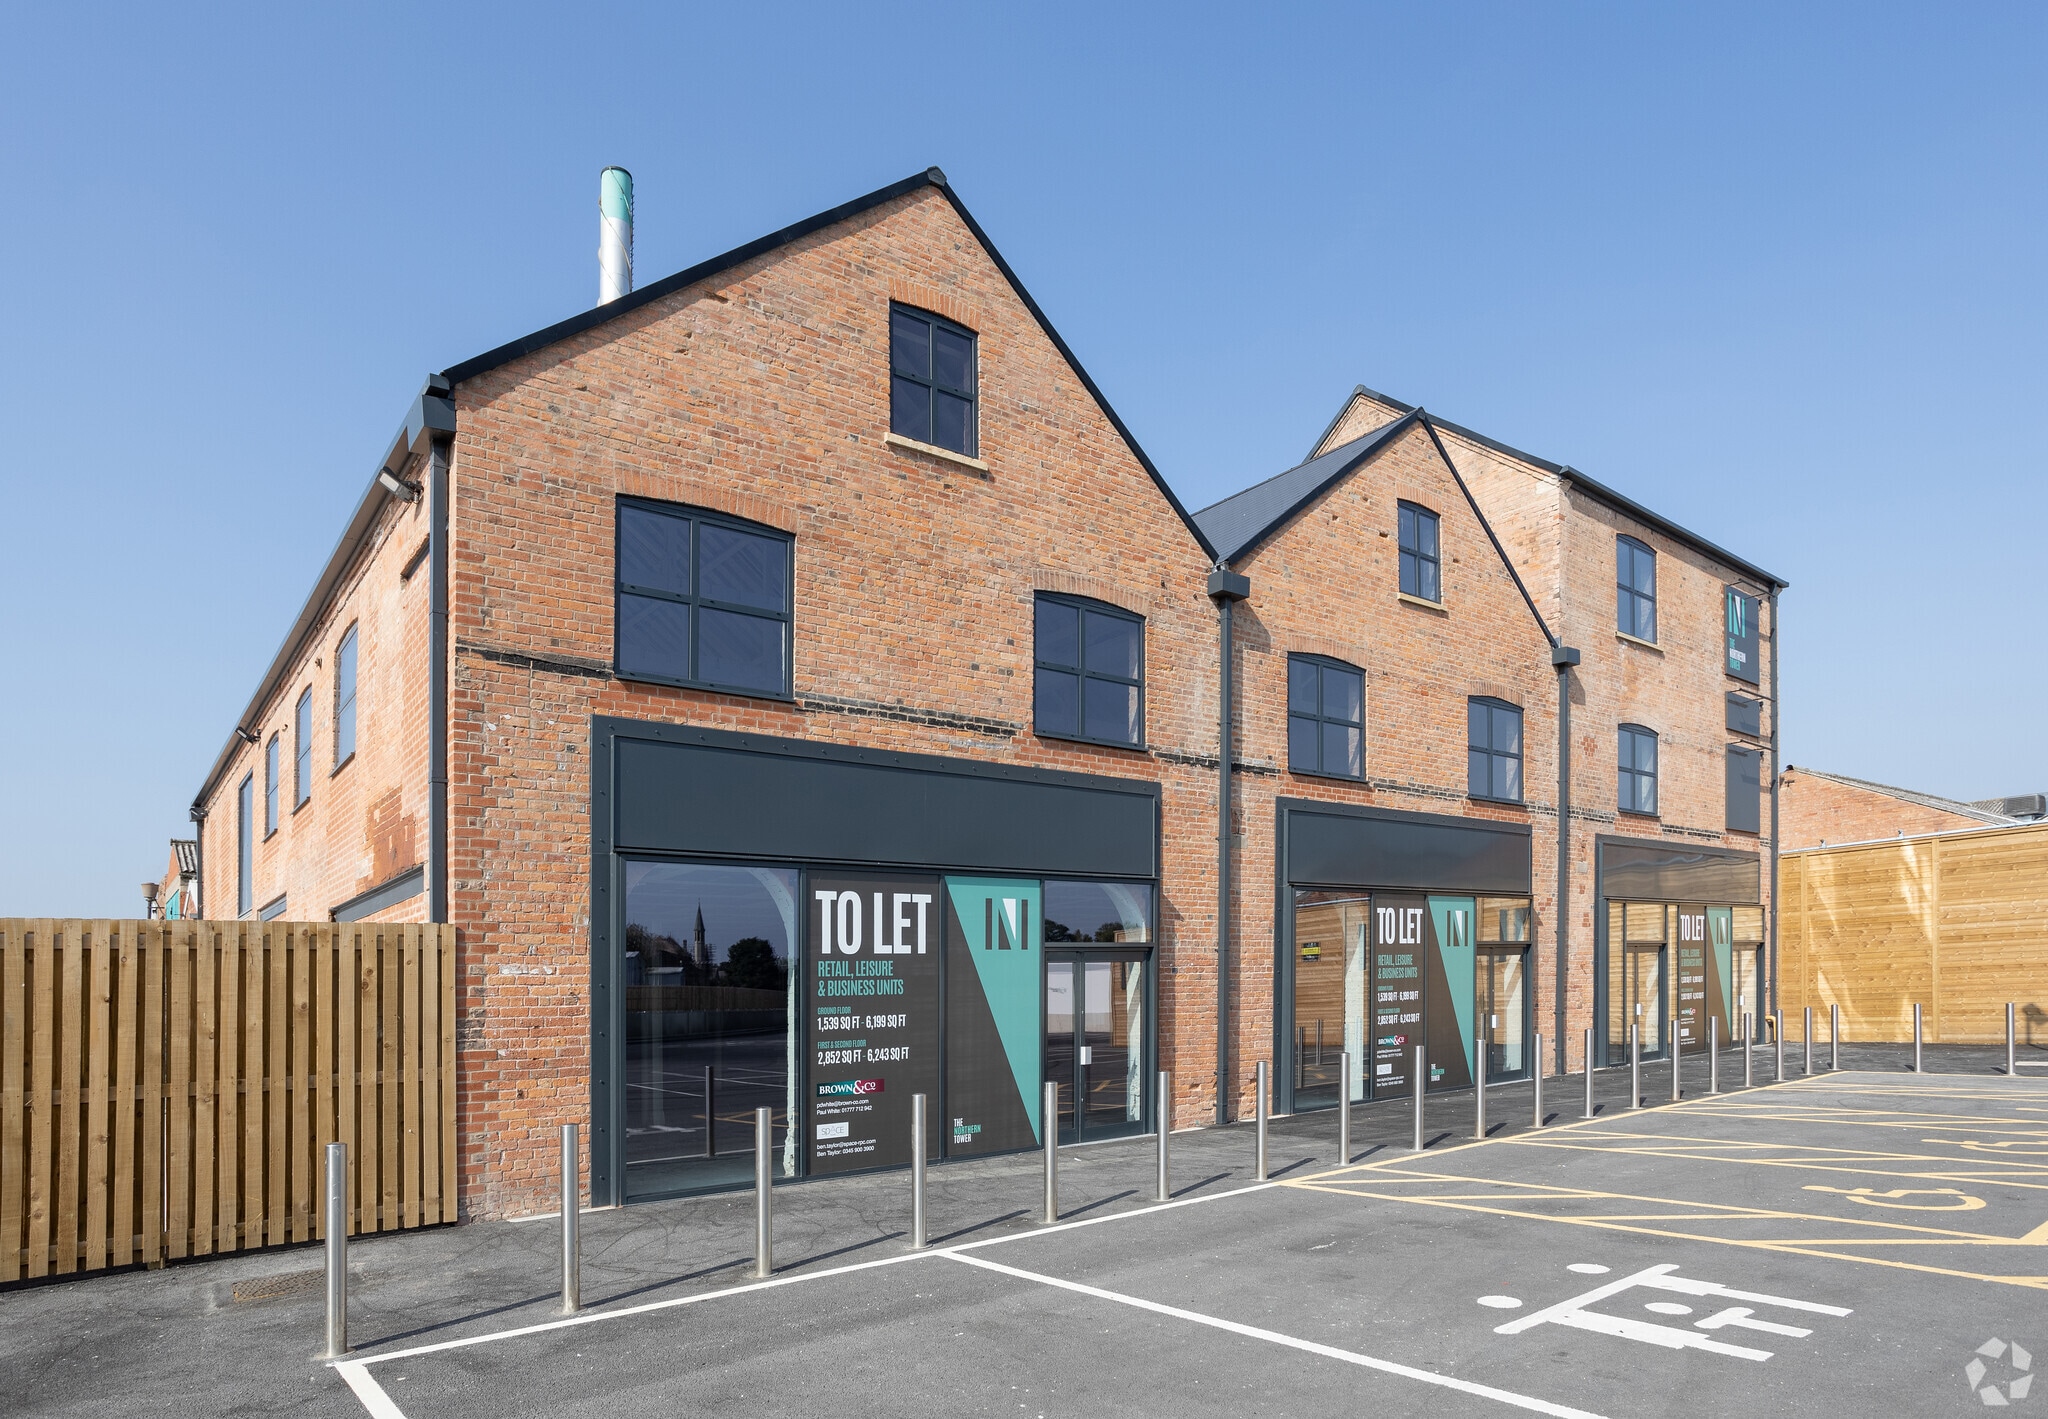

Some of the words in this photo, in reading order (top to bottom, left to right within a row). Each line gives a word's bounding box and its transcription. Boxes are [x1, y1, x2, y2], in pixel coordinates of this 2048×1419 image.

[815, 890, 862, 955] TO
[873, 892, 932, 954] LET
[1377, 907, 1396, 944] TO
[1399, 908, 1423, 944] LET
[1680, 914, 1690, 941] TO
[1691, 914, 1705, 941] LET
[817, 960, 854, 979] RETAIL,
[855, 960, 894, 977] LEISURE
[817, 980, 826, 997] &
[827, 979, 875, 996] BUSINESS
[876, 979, 904, 995] UNITS
[817, 1007, 836, 1015] GROUND
[837, 1006, 852, 1014] FLOOR
[817, 1016, 839, 1033] 1,539
[840, 1016, 851, 1030] SQ
[851, 1015, 861, 1029] FT
[865, 1015, 886, 1030] 6,199
[887, 1014, 897, 1029] SQ
[898, 1013, 907, 1027] FT
[817, 1041, 830, 1050] FIRST
[834, 1040, 853, 1049] SECOND
[852, 1039, 867, 1048] FLOOR
[817, 1050, 841, 1067] 2,852
[841, 1050, 852, 1064] SQ
[853, 1049, 862, 1062] FT
[867, 1047, 889, 1063] 6,243
[890, 1047, 900, 1061] SQ
[901, 1046, 910, 1060] FT
[953, 1118, 963, 1127] THE
[953, 1124, 982, 1135] NORTHERN
[953, 1133, 972, 1144] TOWER
